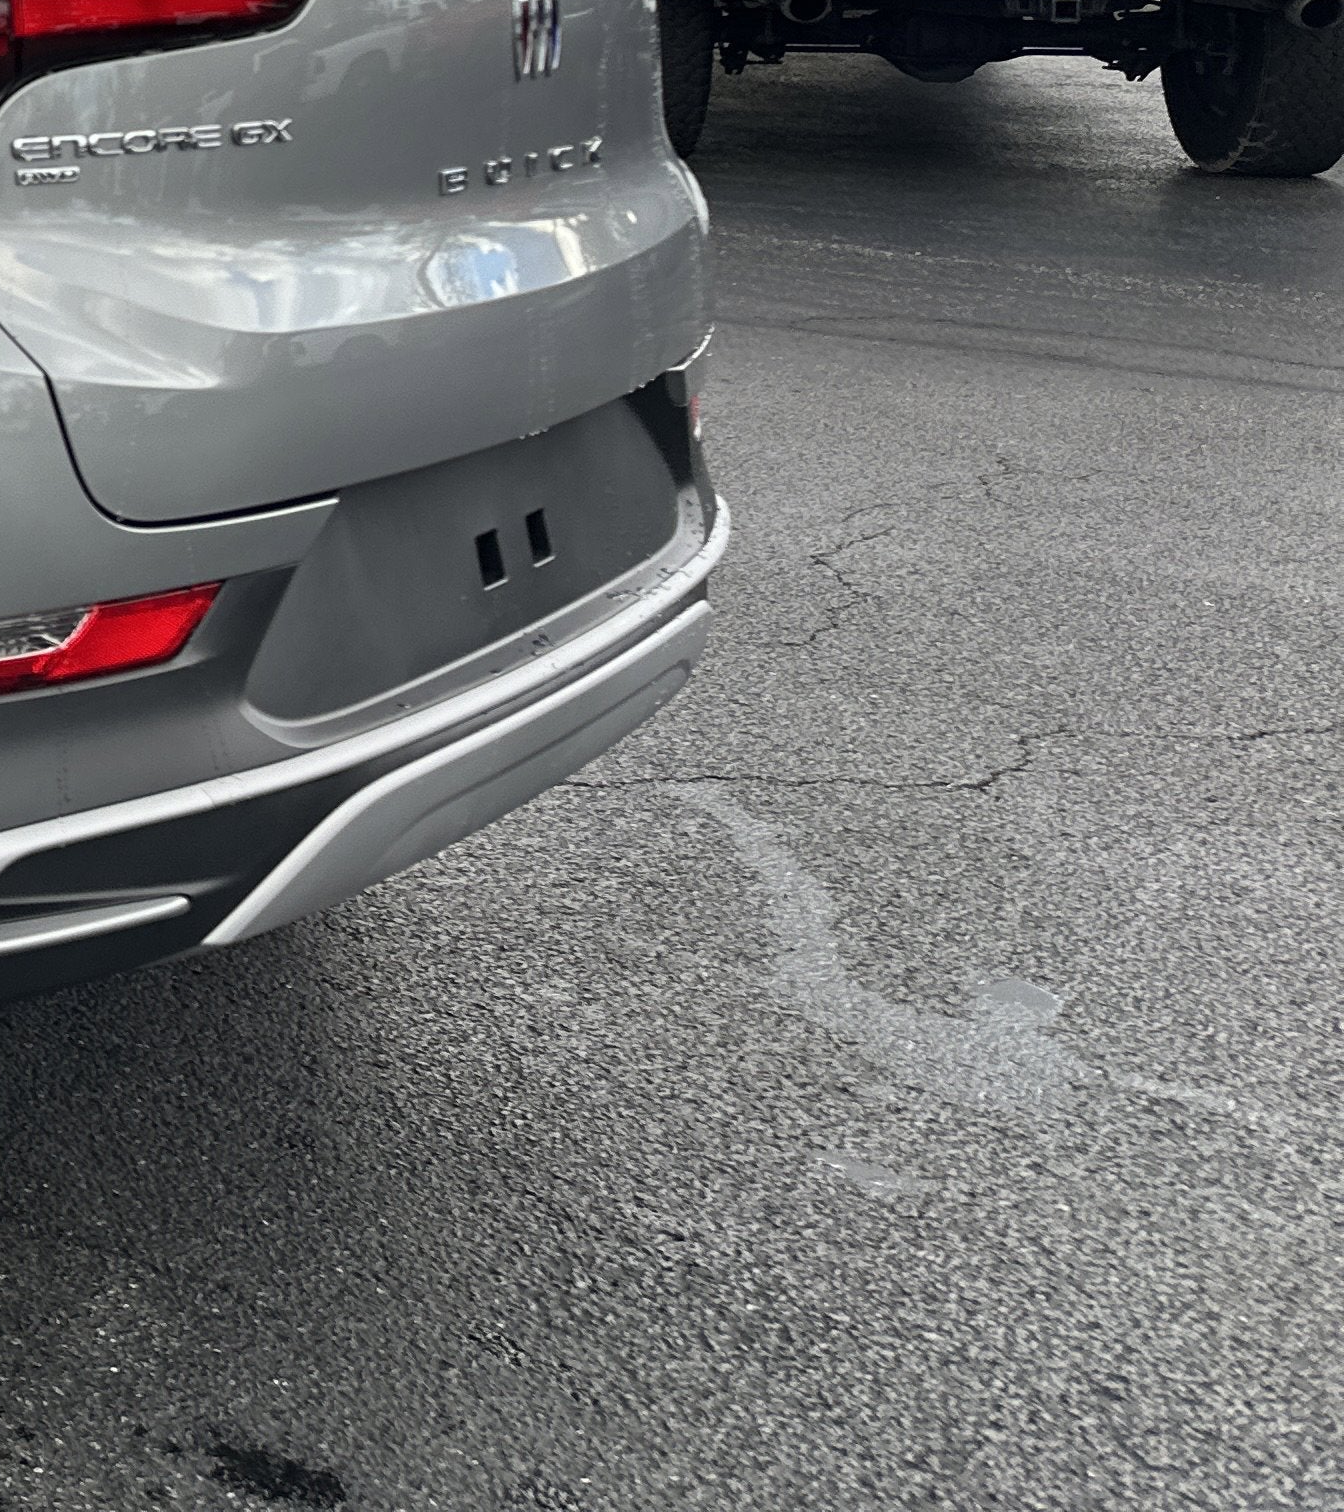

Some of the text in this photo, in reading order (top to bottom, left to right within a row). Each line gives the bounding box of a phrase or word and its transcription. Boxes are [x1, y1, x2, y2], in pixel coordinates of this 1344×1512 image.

[12, 118, 293, 161] ENCORE GX
[438, 135, 603, 195] BUICK
